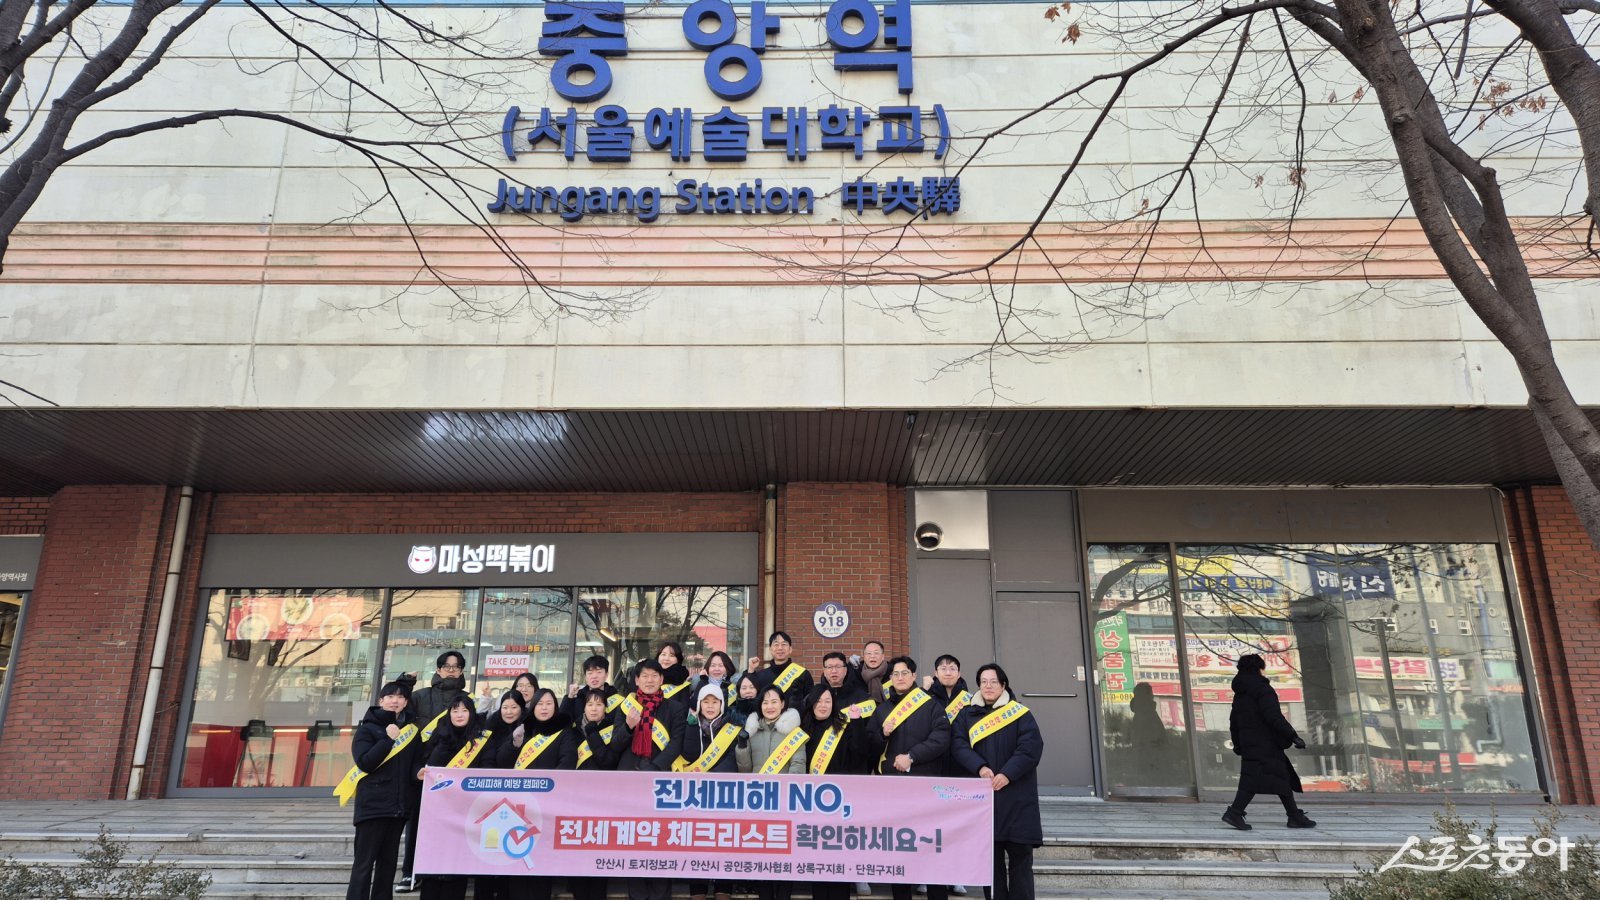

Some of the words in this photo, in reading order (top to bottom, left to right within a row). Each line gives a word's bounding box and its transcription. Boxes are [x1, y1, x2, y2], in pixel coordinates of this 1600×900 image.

[538, 0, 913, 101] 중앙역
[502, 104, 950, 162] (서울예술대학교)
[487, 178, 661, 222] Jungang
[676, 178, 815, 215] Station
[842, 176, 961, 220] 中央驛
[437, 544, 556, 574] 마성떡볶이
[0, 572, 28, 582] 앙역사점
[818, 616, 844, 628] 918
[488, 657, 508, 666] TAKE
[509, 657, 527, 666] OUT
[467, 778, 501, 789] 전세피해
[503, 779, 521, 789] 예방
[523, 779, 548, 790] 캠페인
[654, 779, 779, 811] 전세피해
[789, 783, 851, 817] NO,
[559, 819, 660, 847] 전세계약
[667, 820, 788, 849] 체크리스트
[796, 824, 942, 853] 확인하세요~!
[595, 858, 625, 870] 안산시
[628, 858, 678, 871] 토지정보과
[690, 860, 720, 872] 안산시
[723, 860, 792, 874] 공인중개사협회
[796, 862, 845, 875] 상록구지회
[856, 864, 905, 876] 단원구지회
